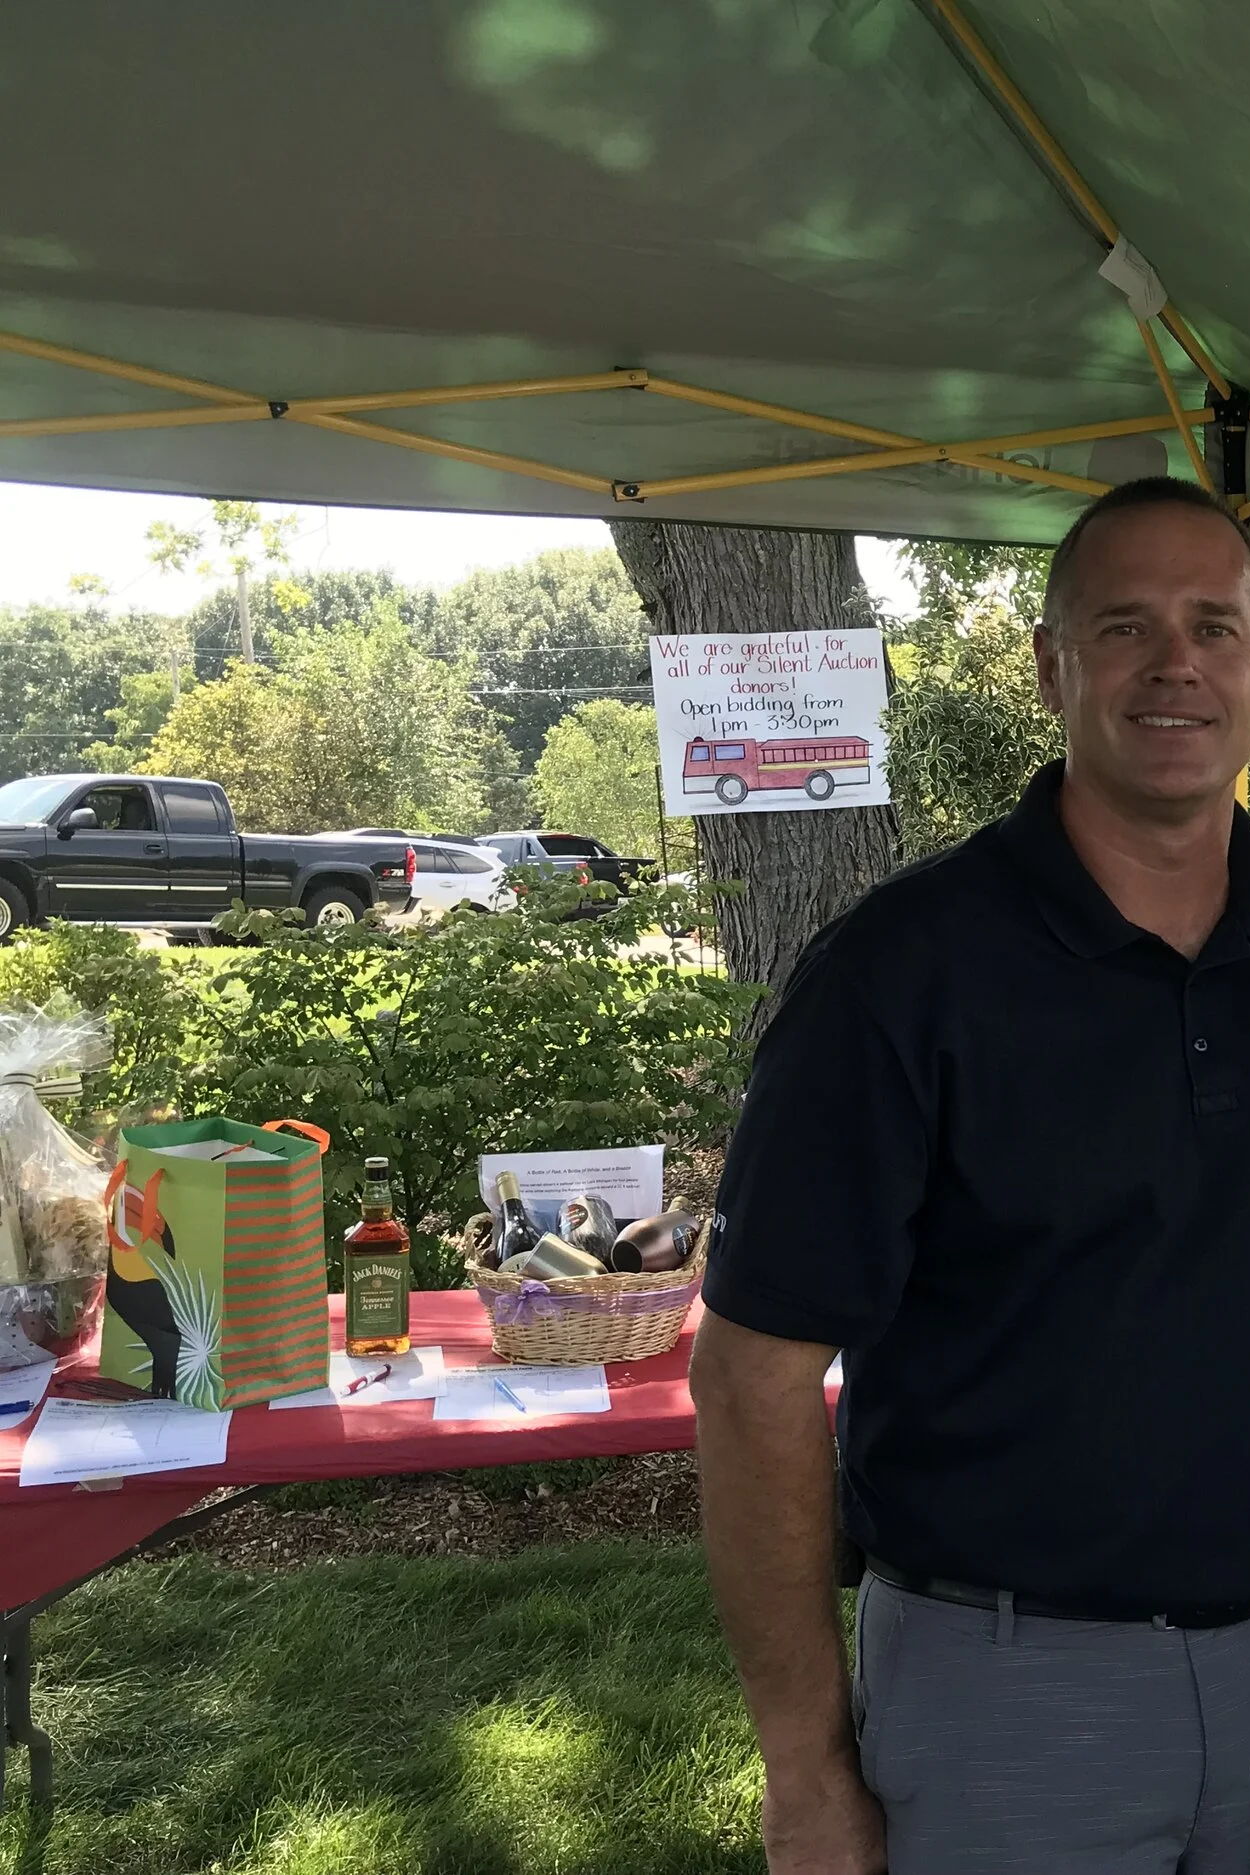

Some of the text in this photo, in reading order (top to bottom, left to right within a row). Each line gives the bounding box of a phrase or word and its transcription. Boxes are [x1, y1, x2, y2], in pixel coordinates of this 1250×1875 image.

[656, 633, 849, 662] We are grateful for
[667, 651, 878, 678] all of our Silent Auction
[730, 676, 797, 696] donors!
[680, 693, 844, 721] Open bidding from
[352, 1264, 402, 1282] JACK DANIEL'S
